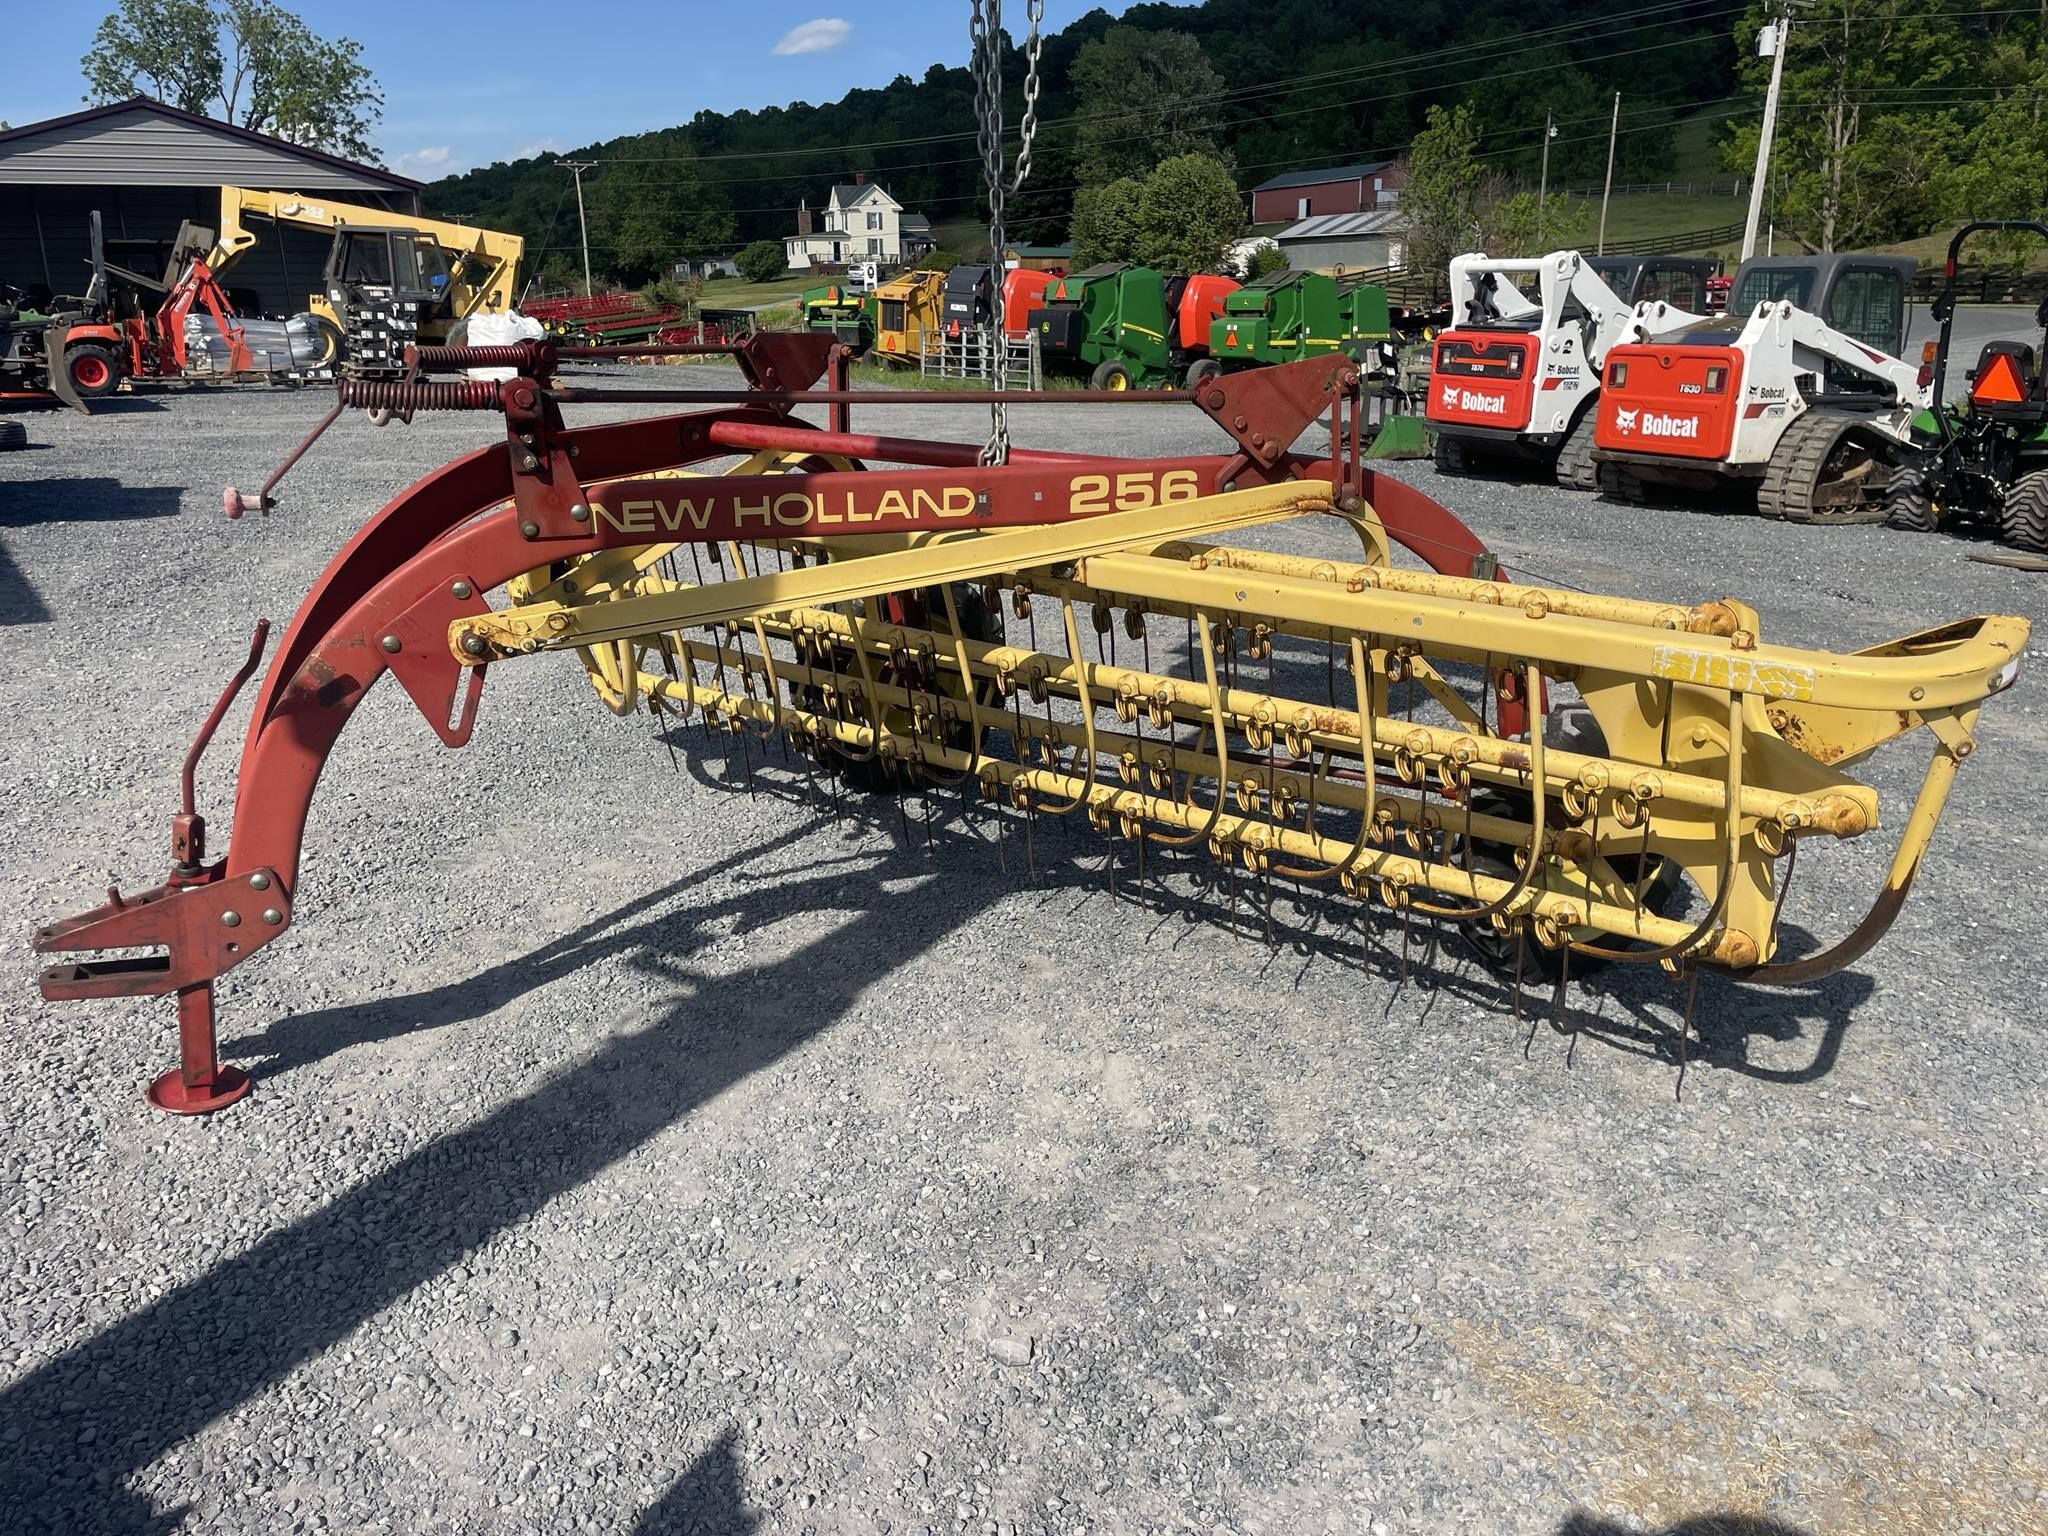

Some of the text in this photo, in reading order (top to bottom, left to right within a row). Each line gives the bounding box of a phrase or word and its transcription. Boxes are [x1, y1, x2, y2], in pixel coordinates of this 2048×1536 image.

[1557, 364, 1580, 375] Bobcat
[1461, 391, 1505, 414] Bobcat
[1760, 387, 1785, 399] Bobcat
[1641, 413, 1699, 438] Bobcat
[589, 470, 1198, 534] NEW HOLLAND 256
